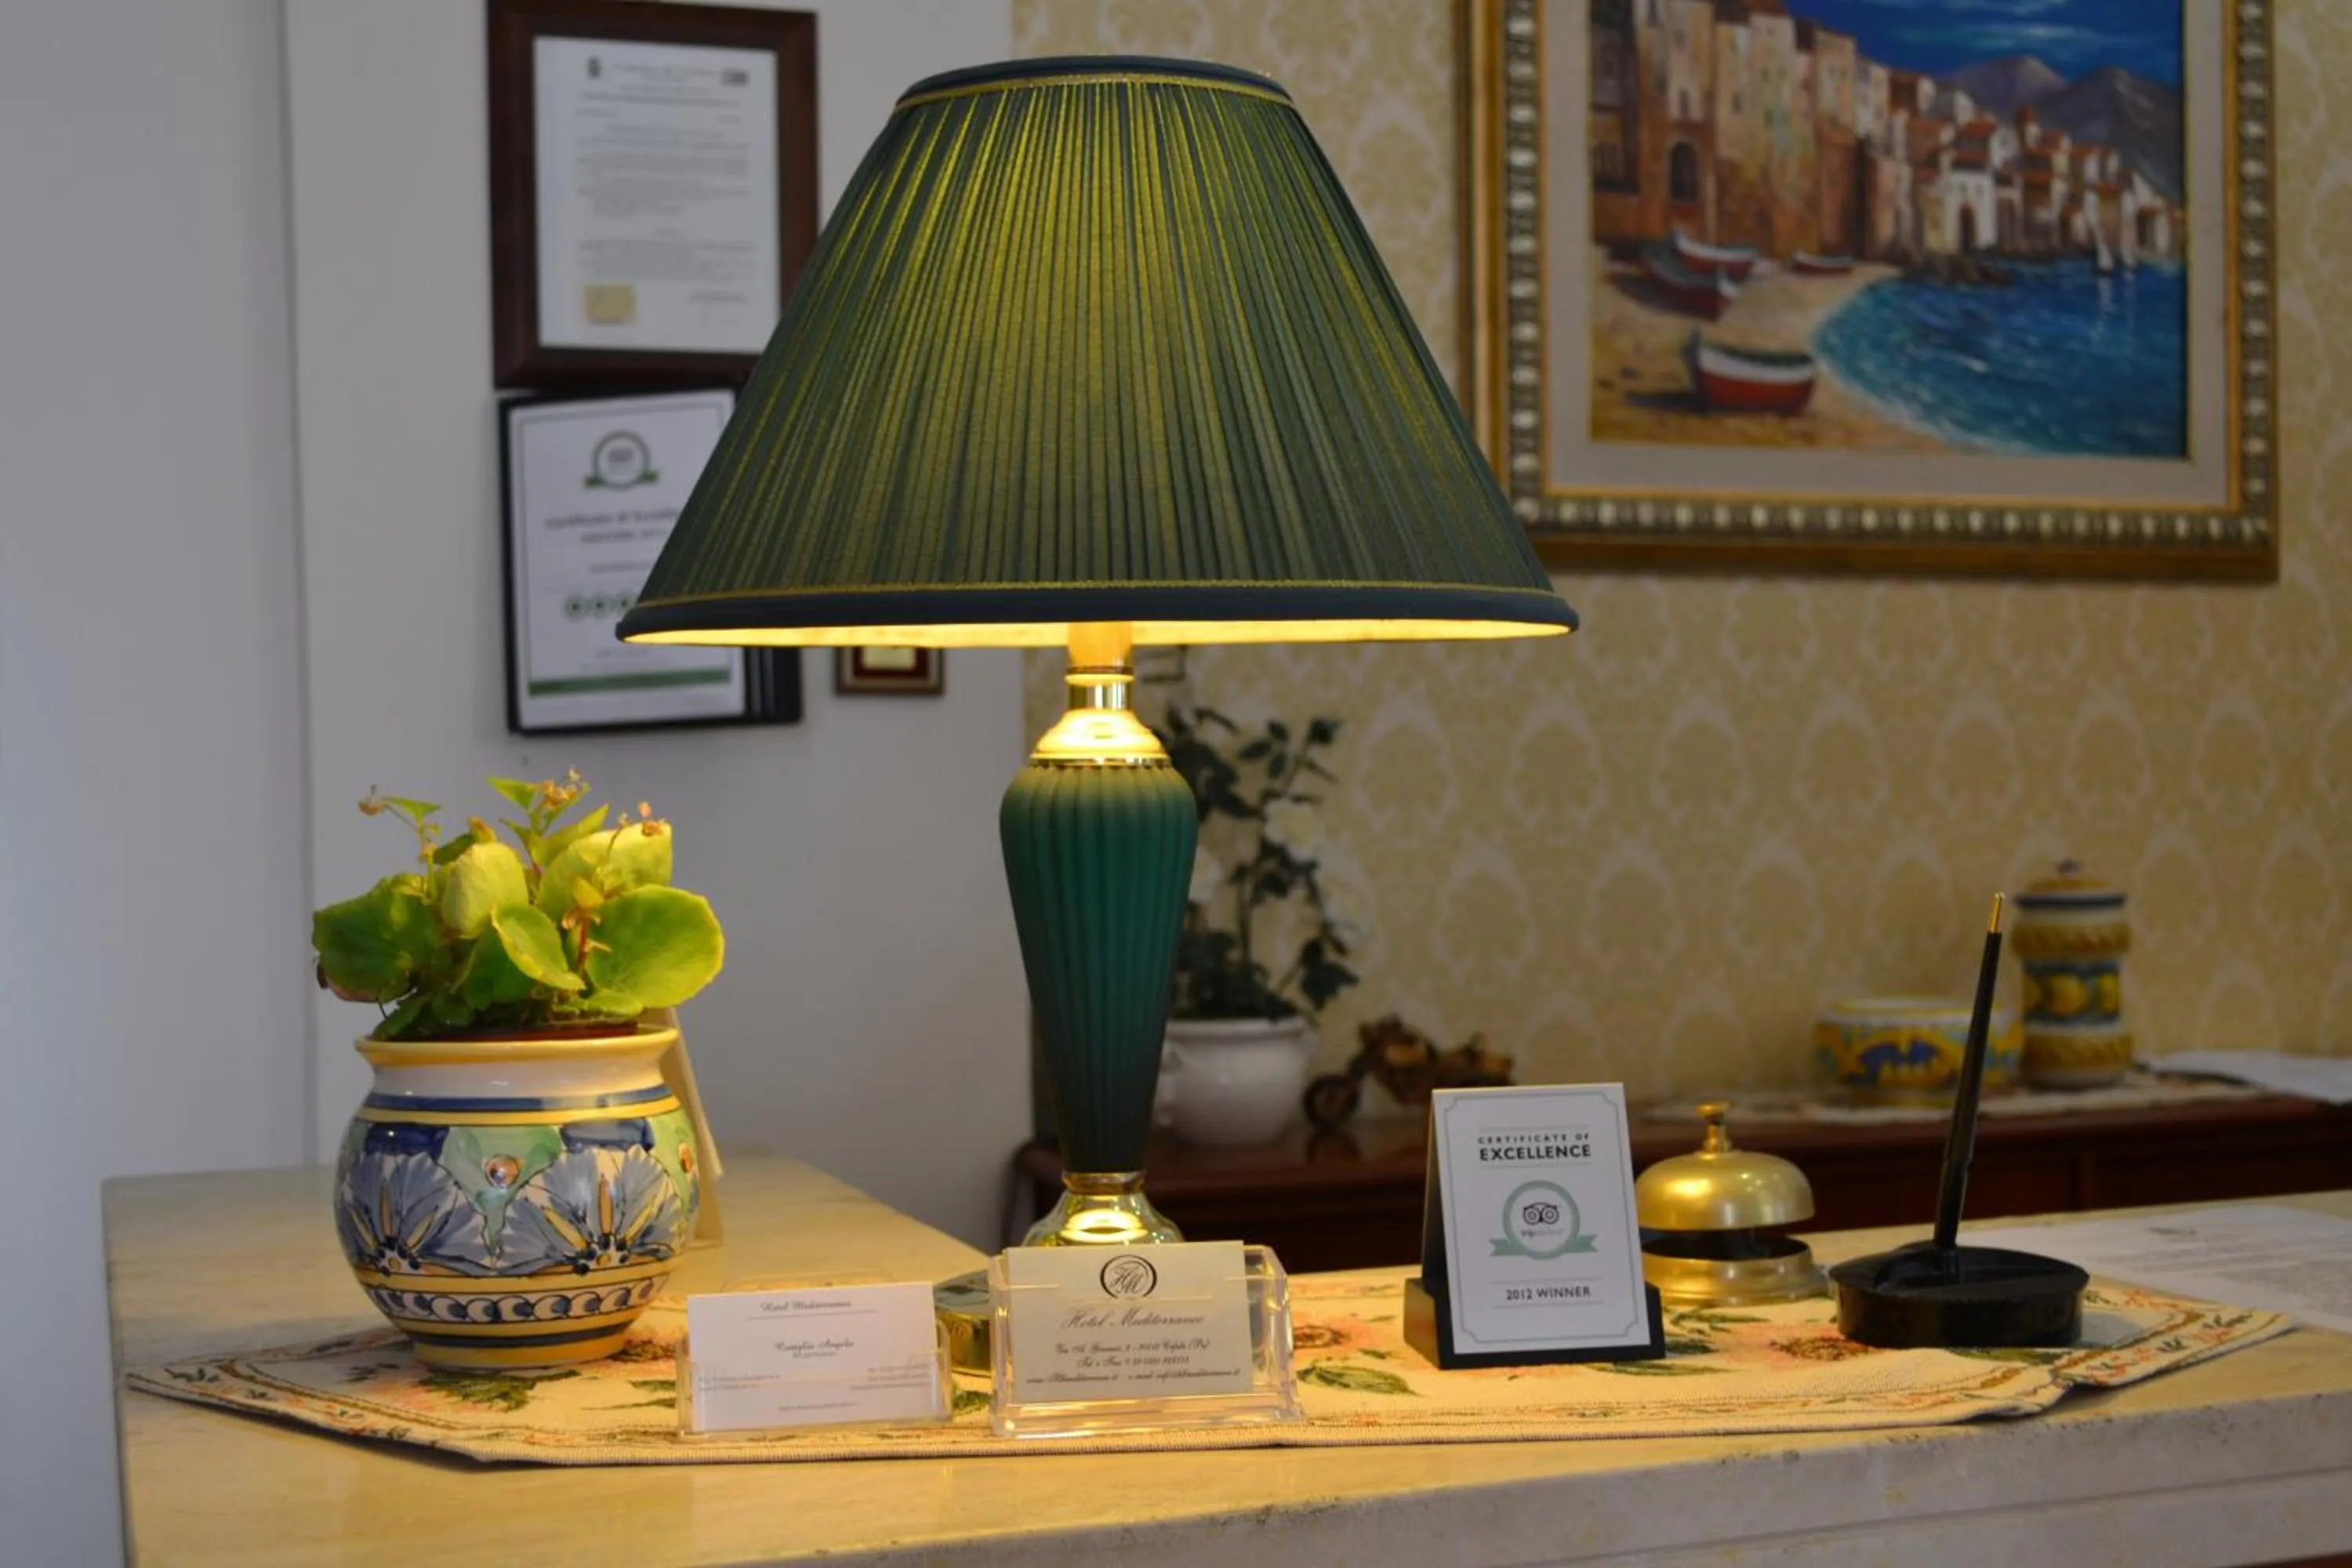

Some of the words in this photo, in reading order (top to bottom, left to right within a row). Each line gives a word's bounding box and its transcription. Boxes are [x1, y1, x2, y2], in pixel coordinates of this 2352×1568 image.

[1478, 1133, 1567, 1144] CERTIFICATE
[1574, 1132, 1589, 1142] OF
[1479, 1144, 1592, 1161] EXCELLENCE
[1505, 1288, 1533, 1301] 2012
[1536, 1286, 1591, 1298] WINNER
[1061, 1307, 1112, 1329] Hotel
